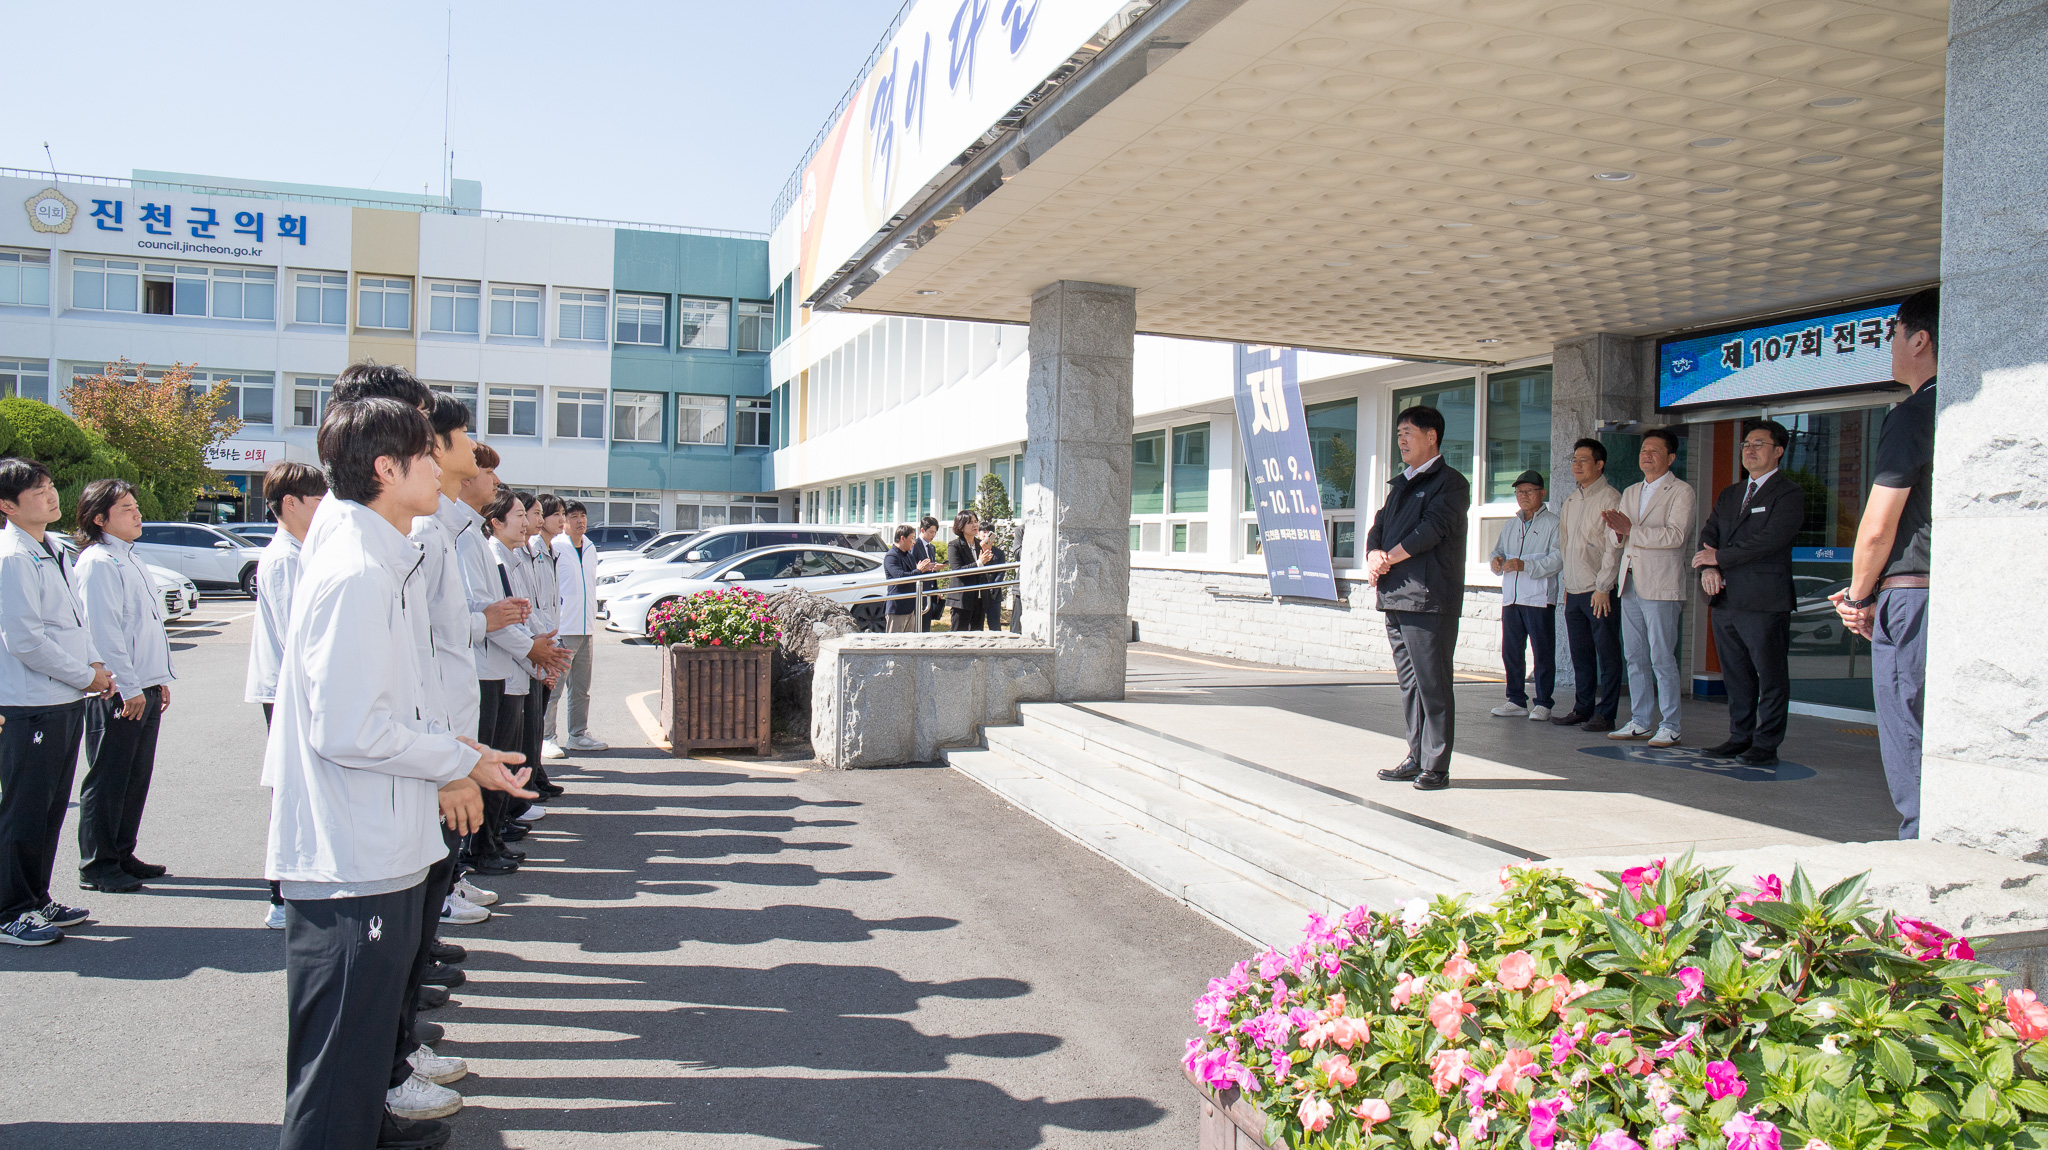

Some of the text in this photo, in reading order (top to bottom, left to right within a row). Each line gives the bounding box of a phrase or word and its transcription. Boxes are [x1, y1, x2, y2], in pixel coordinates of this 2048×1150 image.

[38, 205, 64, 220] 의회
[89, 199, 307, 246] 진천군의회
[137, 240, 263, 257] council.jincheon.go.kr
[1721, 340, 1743, 369] 제
[1751, 327, 1823, 363] 107회
[1246, 344, 1290, 436] 제
[244, 448, 267, 464] 의회
[1262, 457, 1284, 483] 10.
[1287, 455, 1302, 481] 9.
